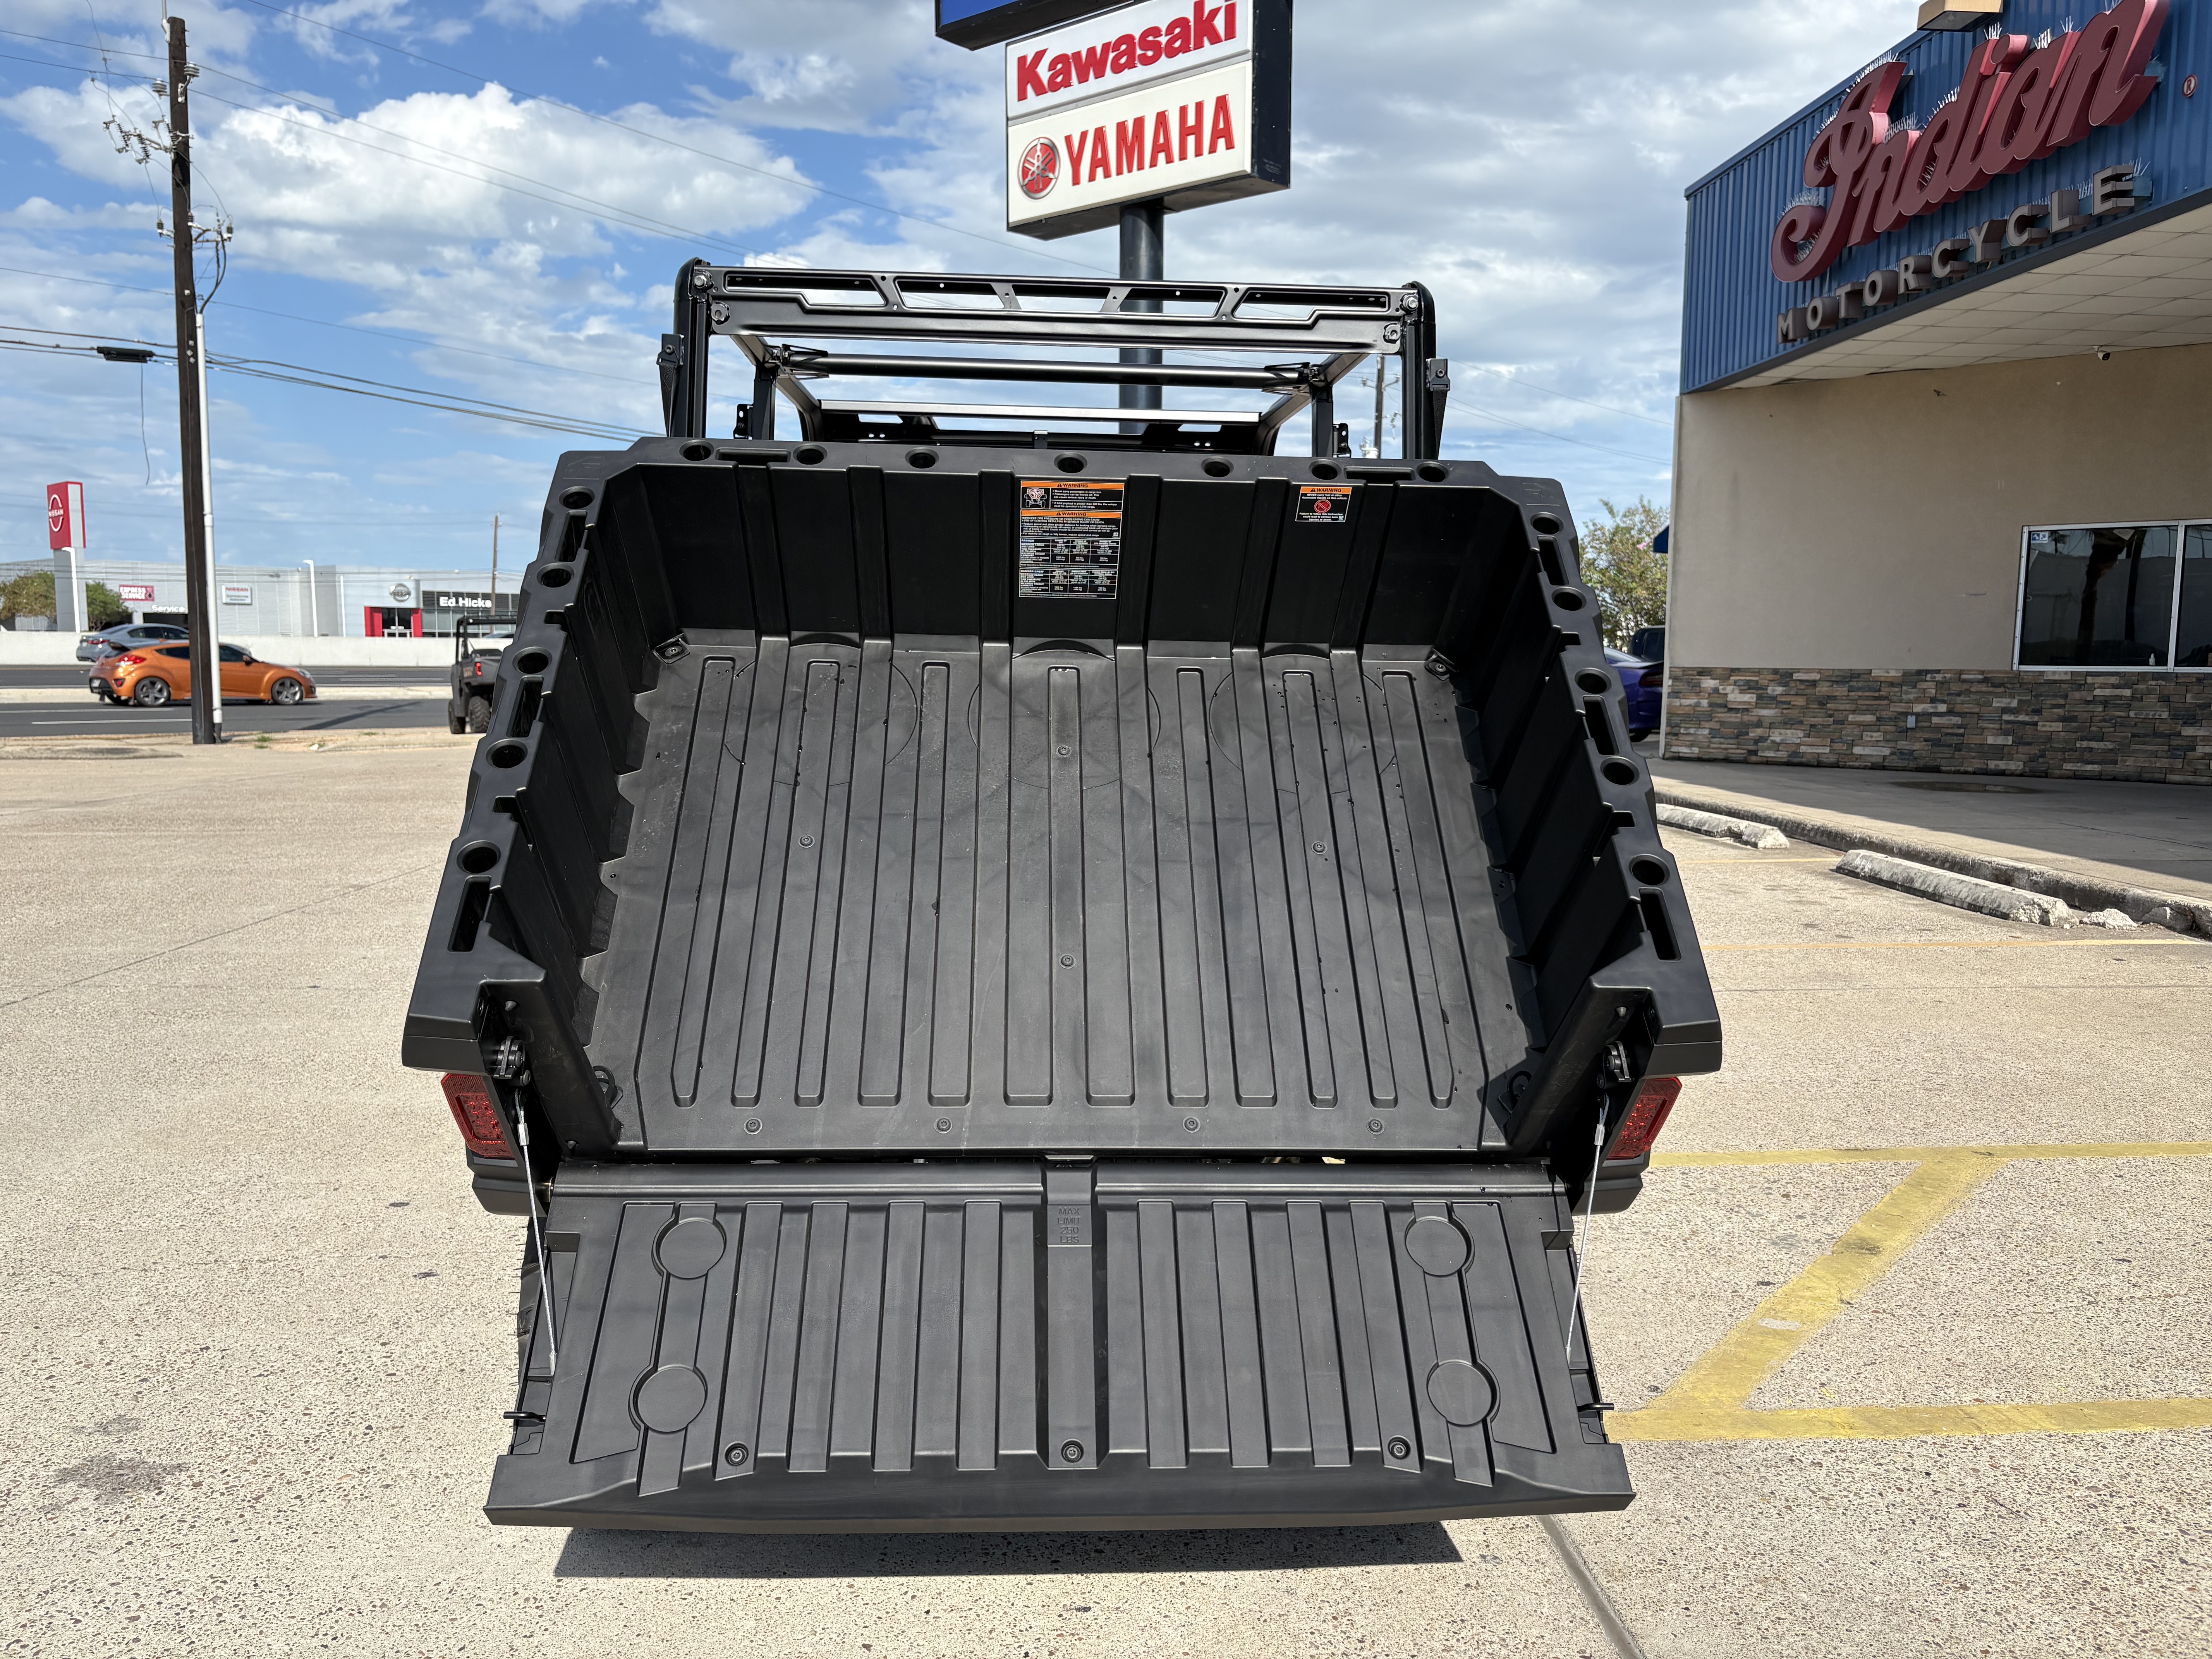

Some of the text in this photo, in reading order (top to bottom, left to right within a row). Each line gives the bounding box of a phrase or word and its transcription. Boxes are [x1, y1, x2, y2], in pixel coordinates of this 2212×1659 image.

[1017, 0, 1237, 102] Kawasaki
[1065, 94, 1235, 186] YAMAHA
[1771, 0, 2169, 283] Indian
[1778, 165, 2135, 344] MOTORCYCLE
[439, 596, 492, 608] Ed Hicks
[151, 604, 185, 613] Service
[1057, 1216, 1081, 1224] LIMIT
[1060, 1225, 1079, 1234] 250
[1060, 1235, 1079, 1243] LBS
